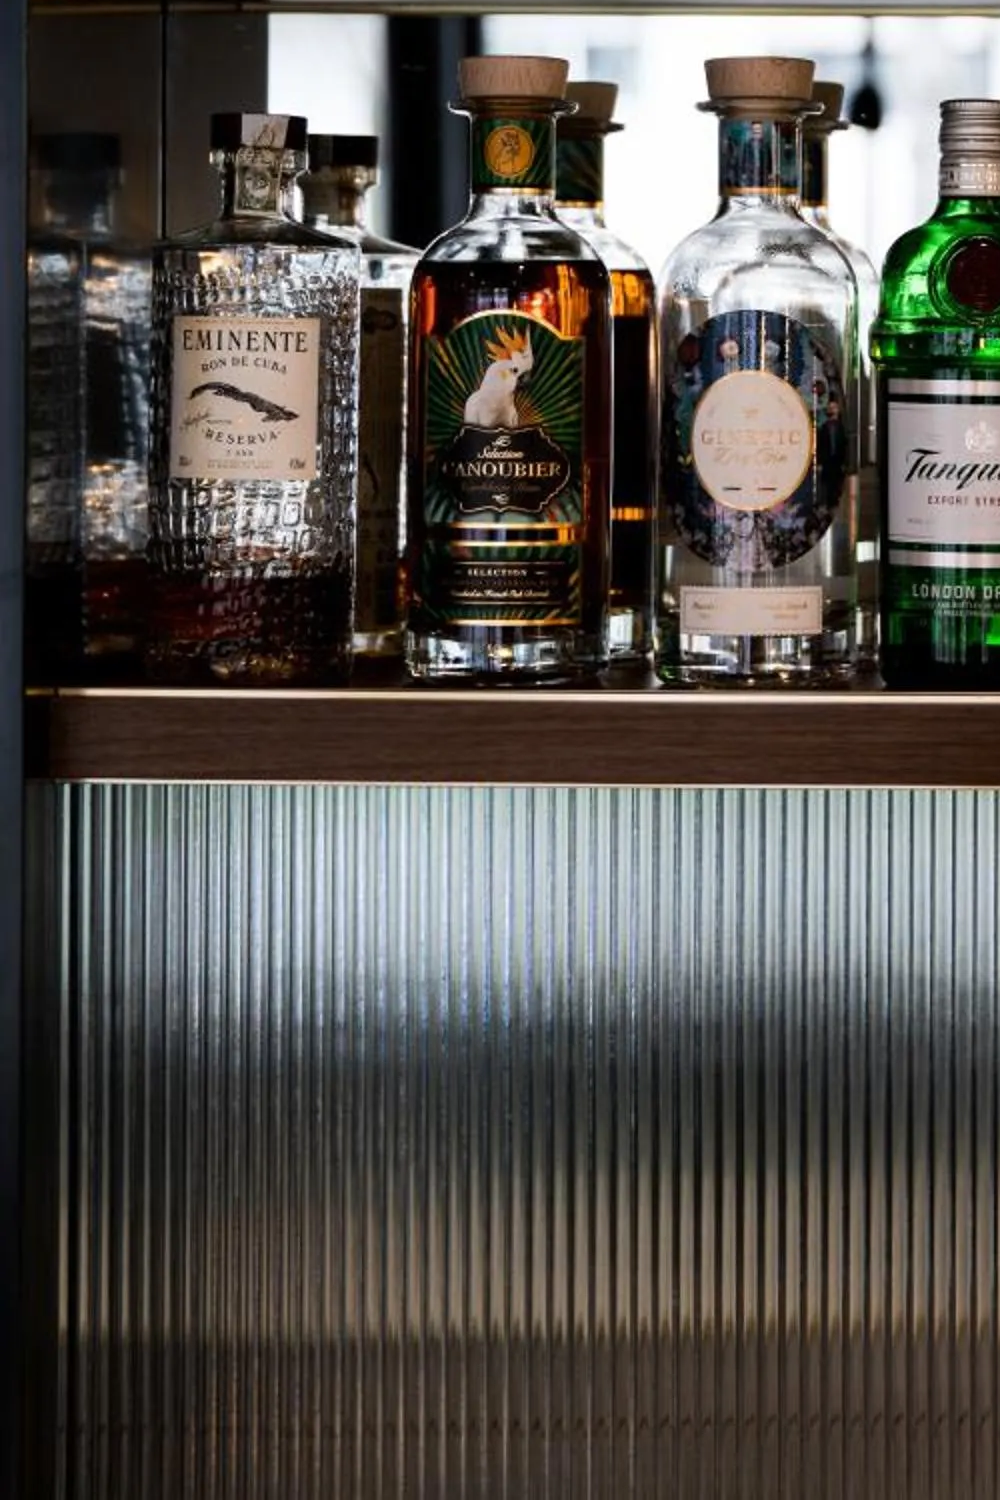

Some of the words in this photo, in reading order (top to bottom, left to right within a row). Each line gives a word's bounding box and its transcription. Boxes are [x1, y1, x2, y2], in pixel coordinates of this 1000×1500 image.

[183, 329, 308, 353] EMINENTE
[201, 357, 227, 373] RON
[231, 356, 249, 367] DE
[253, 357, 287, 375] CUBA
[927, 495, 969, 505] EXPORT
[911, 583, 976, 599] LONDON
